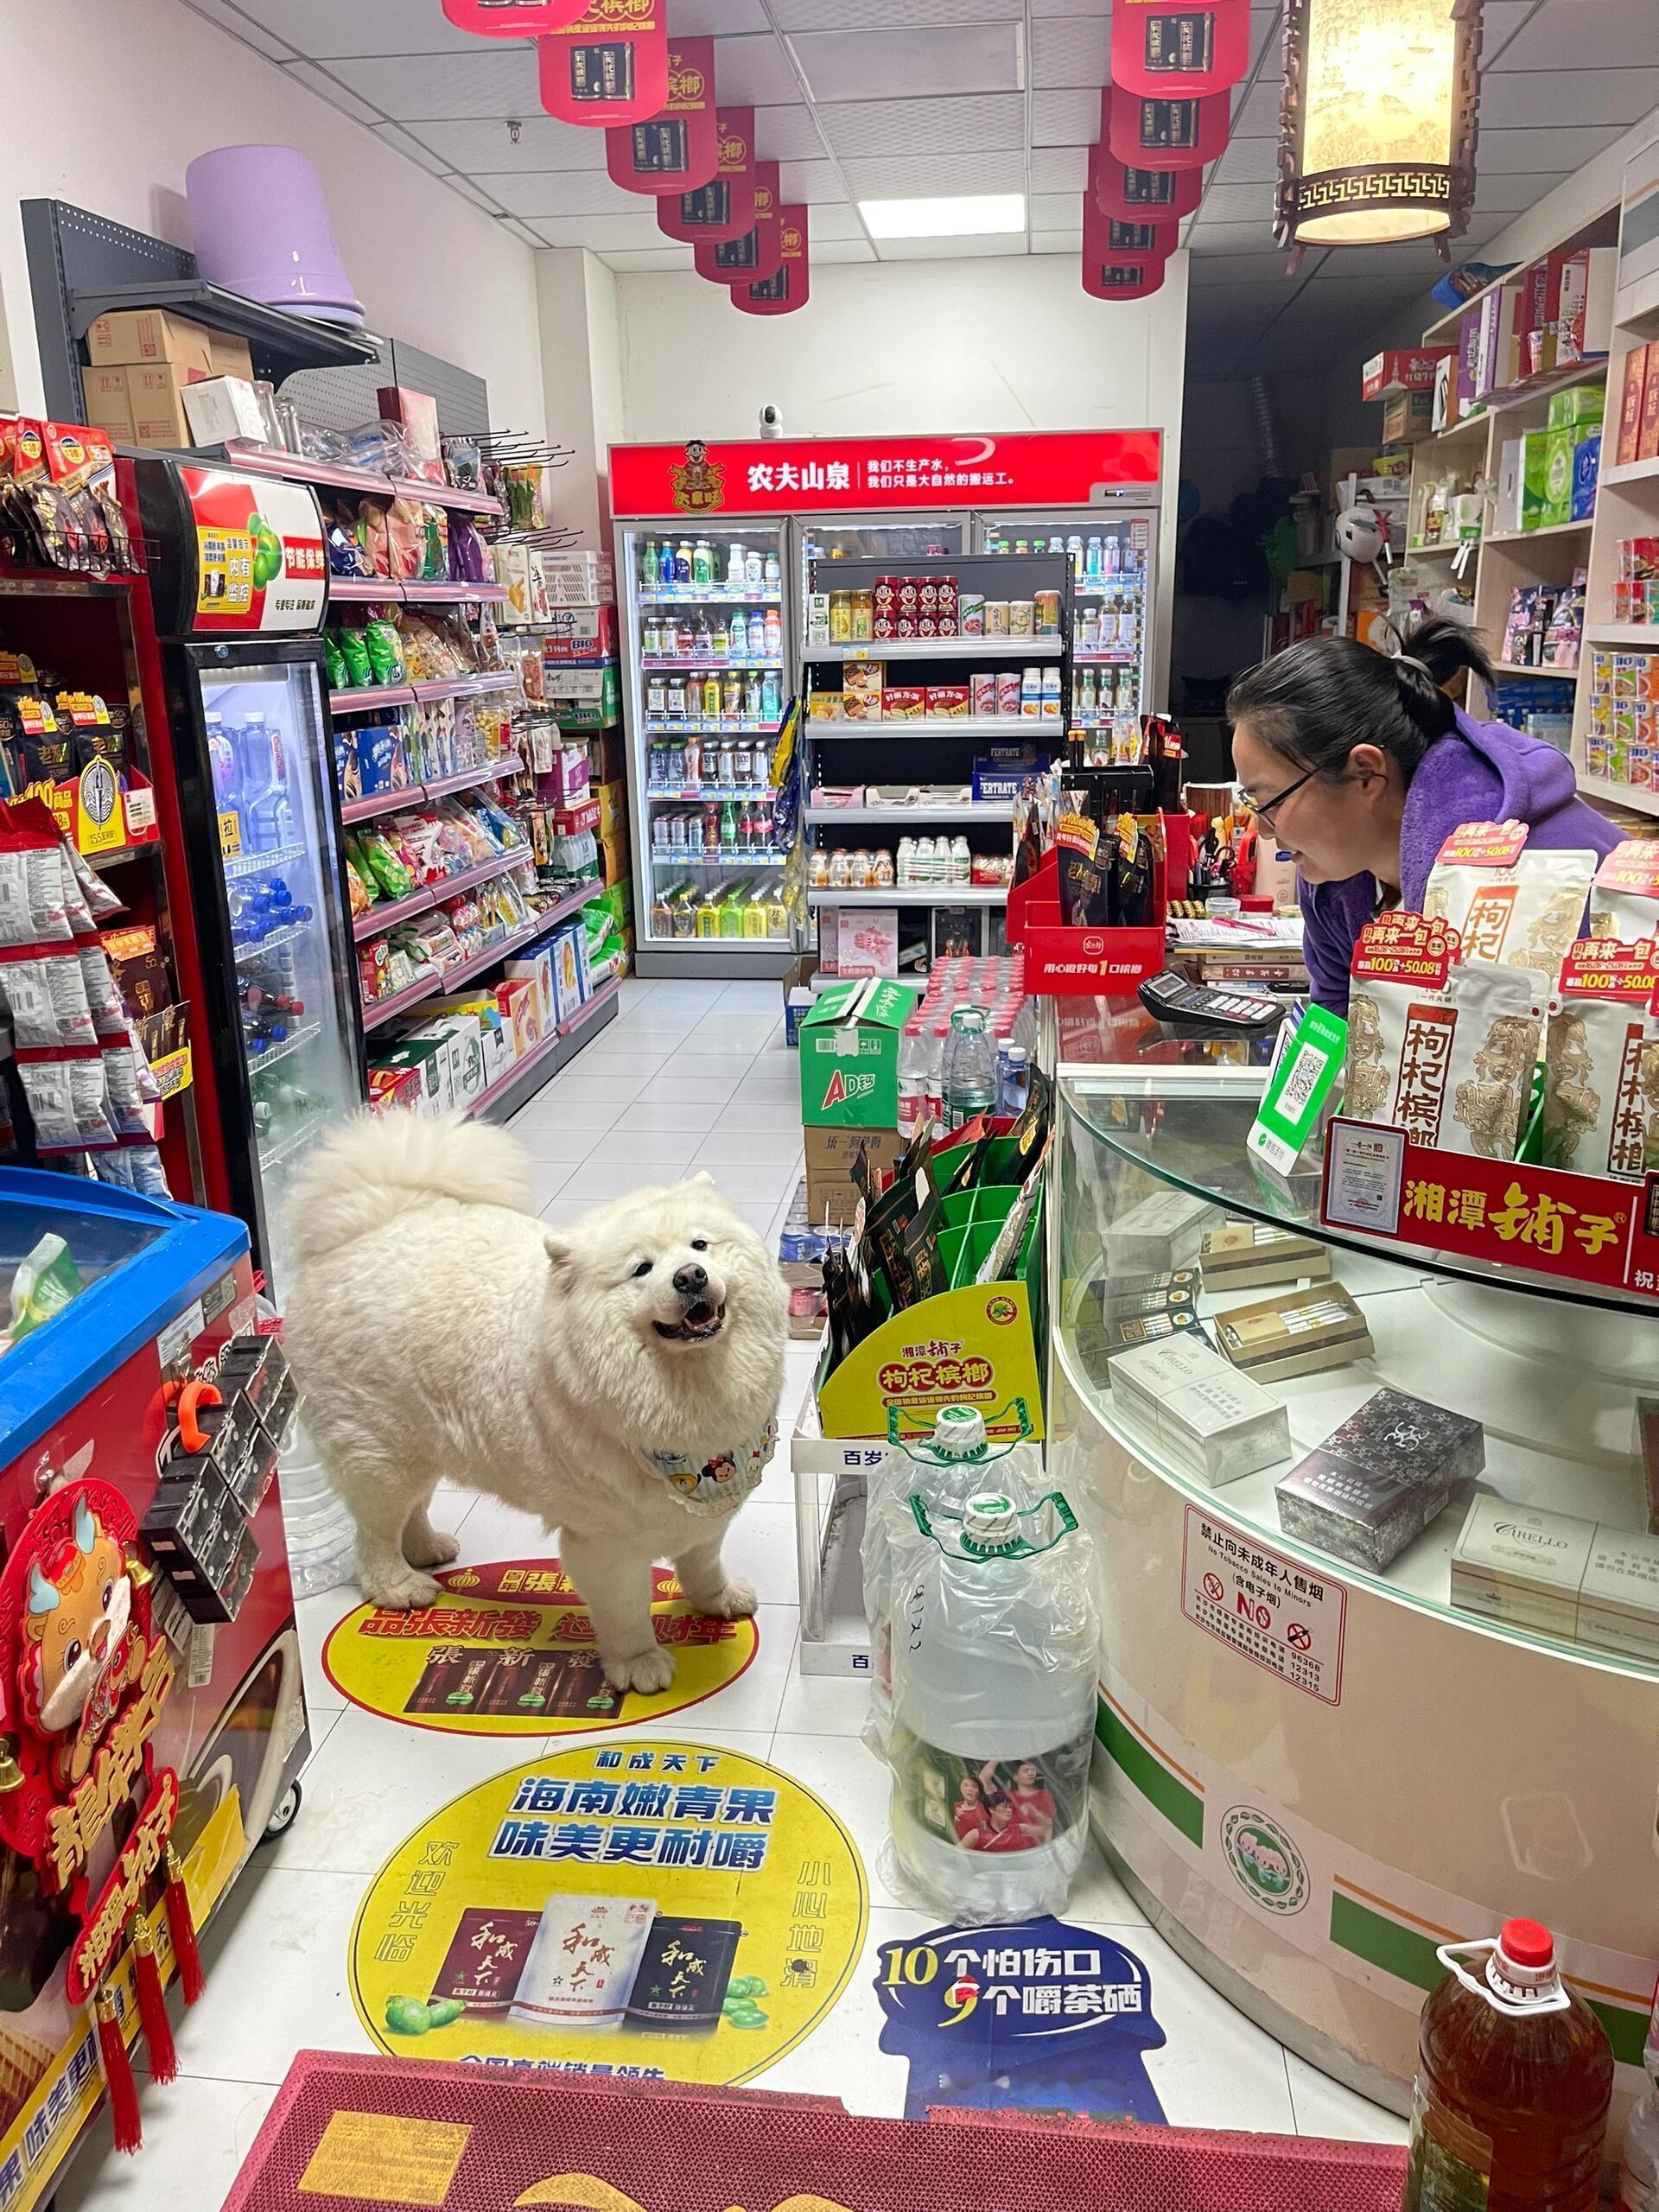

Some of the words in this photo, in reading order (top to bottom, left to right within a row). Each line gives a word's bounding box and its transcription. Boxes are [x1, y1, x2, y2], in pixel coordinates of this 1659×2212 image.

[747, 461, 850, 493] 农夫山泉
[867, 472, 1014, 490] 我们只是大自然的搬运工。
[1371, 925, 1428, 945] 再来一包
[1581, 940, 1650, 961] 再来一包
[1370, 957, 1395, 972] 100
[1405, 959, 1436, 976] 50.08
[1580, 974, 1611, 989] 100
[883, 1362, 990, 1389] 枸杞槟榔
[843, 1449, 889, 1466] 百岁
[1493, 1521, 1568, 1549] CIRELLO
[1200, 1522, 1324, 1602] 禁止向未成年人售烟
[1208, 1544, 1217, 1556] No
[1219, 1551, 1249, 1575] Tobacco
[1251, 1570, 1271, 1588] Sales
[1274, 1582, 1282, 1592] to
[1284, 1588, 1312, 1608] Minors
[1232, 1572, 1281, 1609] (含电子烟)
[1290, 1662, 1320, 1682] 12313
[1291, 1651, 1321, 1673] 96368
[1290, 1671, 1319, 1692] 12315
[593, 1748, 720, 1774] 和成天下
[512, 1776, 778, 1827] 海南嫩青果
[487, 1820, 772, 1872] 味美更耐嚼
[373, 1840, 461, 1964] 欢迎光临
[779, 1859, 832, 1988] 小心地滑
[471, 1921, 518, 1986] 和成天下
[562, 1922, 616, 1993] 和成天下
[881, 1946, 1101, 1985] 10个怕伤口
[659, 1939, 708, 1999] 和成天下
